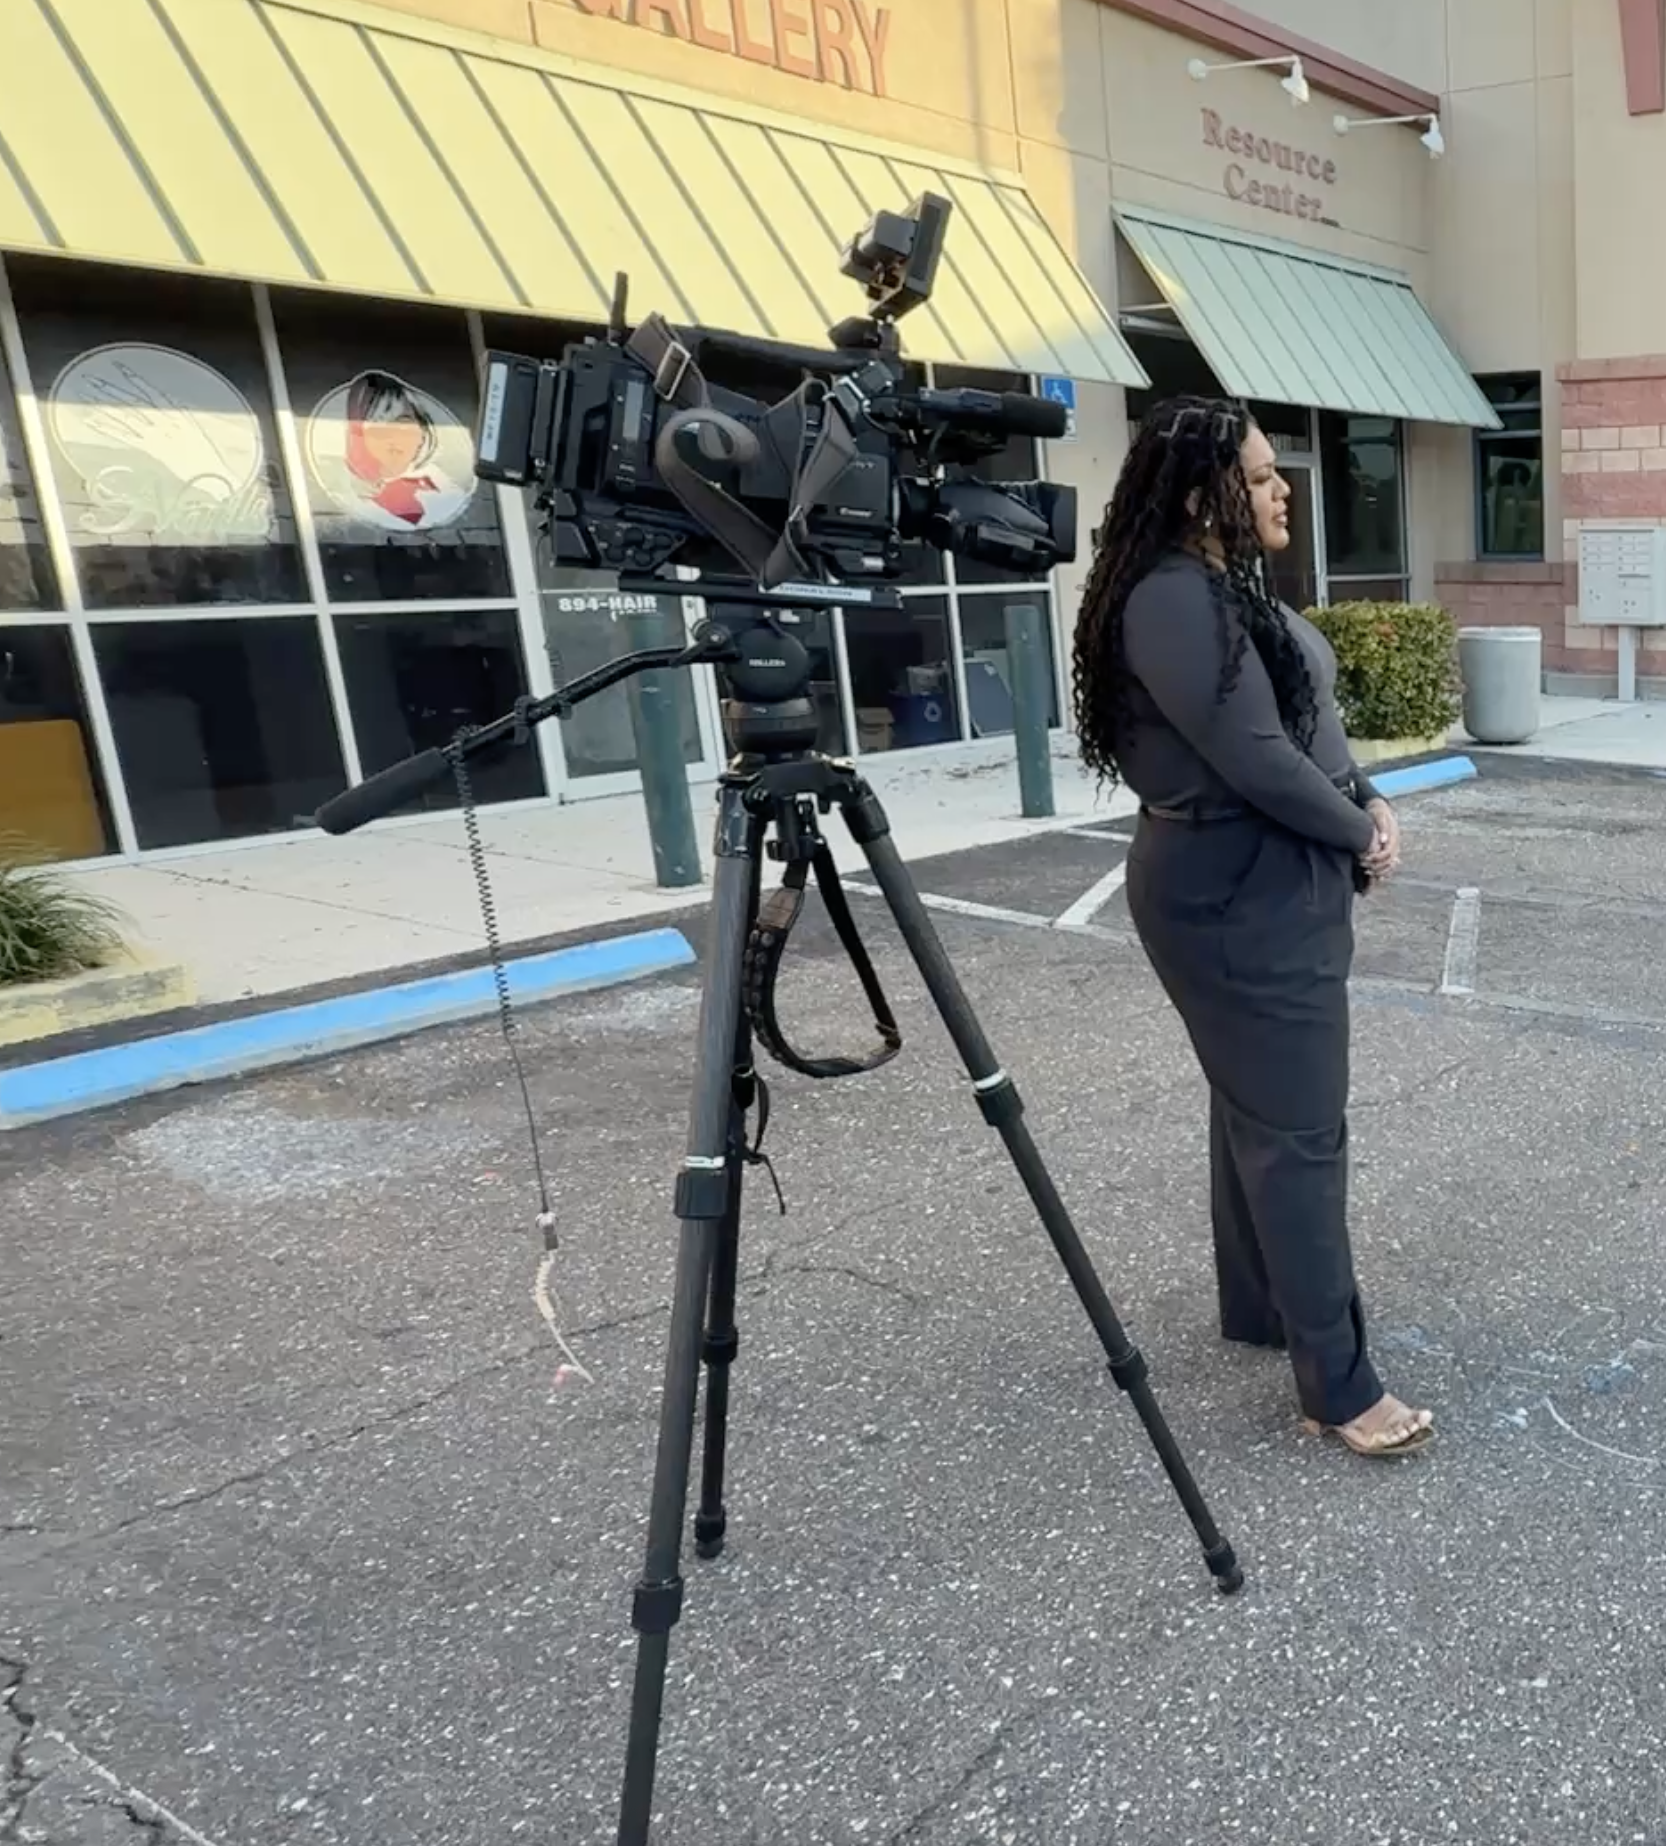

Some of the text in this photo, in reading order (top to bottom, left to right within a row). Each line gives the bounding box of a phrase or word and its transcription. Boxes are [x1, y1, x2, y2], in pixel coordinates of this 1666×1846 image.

[572, 0, 892, 98] LLERY
[1201, 107, 1337, 185] Resource
[1223, 163, 1323, 222] Center
[558, 595, 658, 612] 894-HAIR
